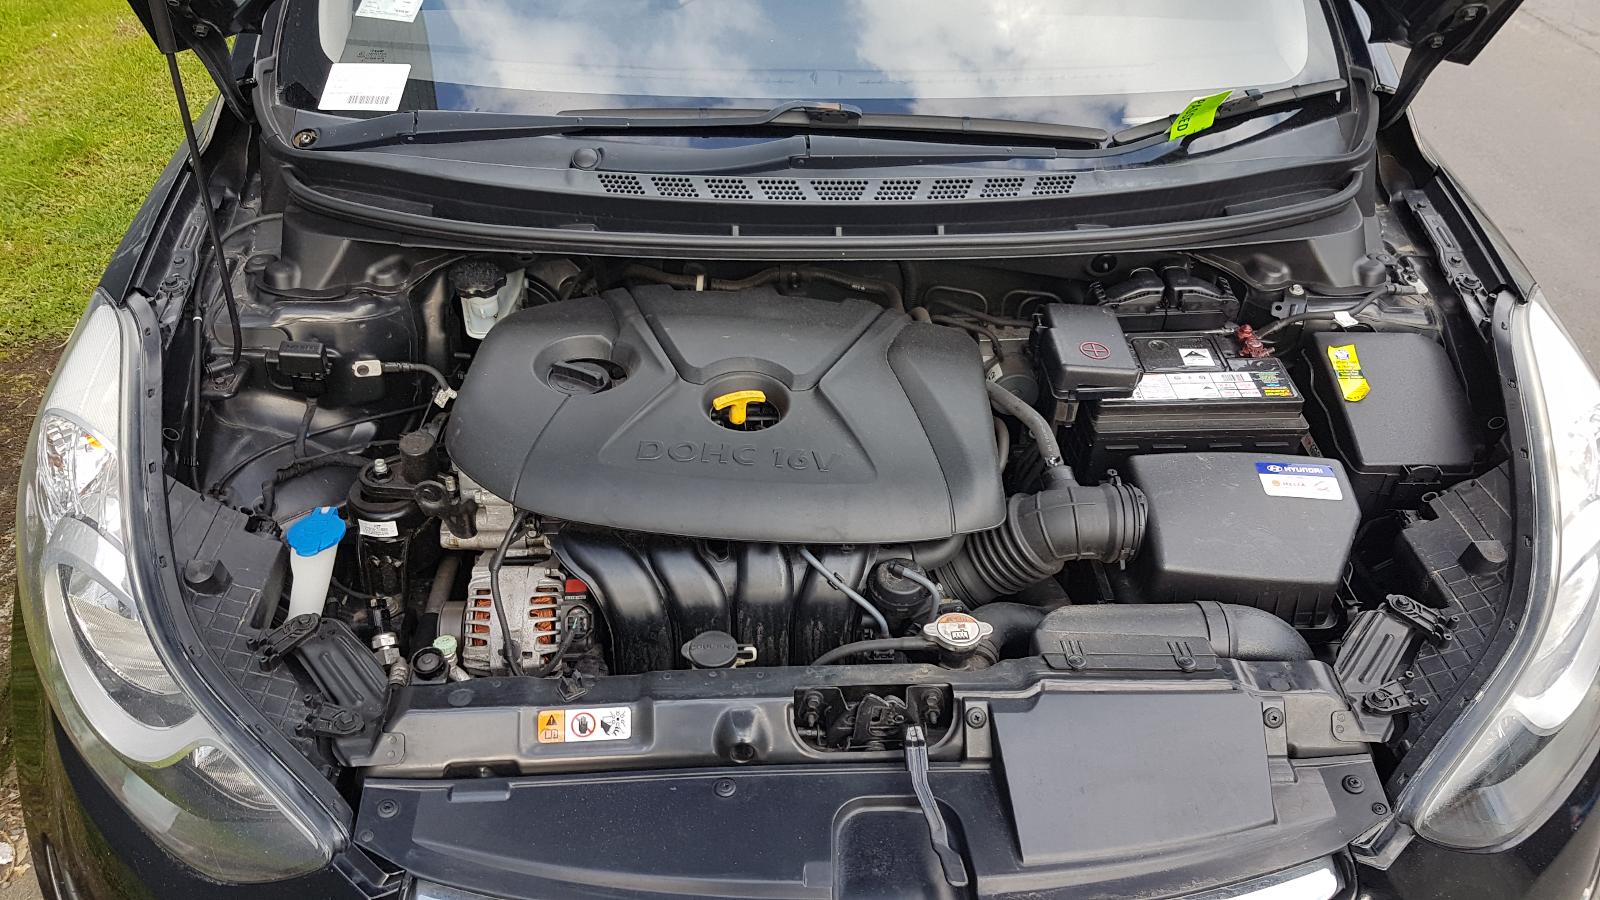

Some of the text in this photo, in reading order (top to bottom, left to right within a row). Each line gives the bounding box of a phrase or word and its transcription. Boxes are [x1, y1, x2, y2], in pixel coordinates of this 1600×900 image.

[636, 440, 841, 472] DOHC 16V
[1283, 466, 1324, 474] HYUNDAI
